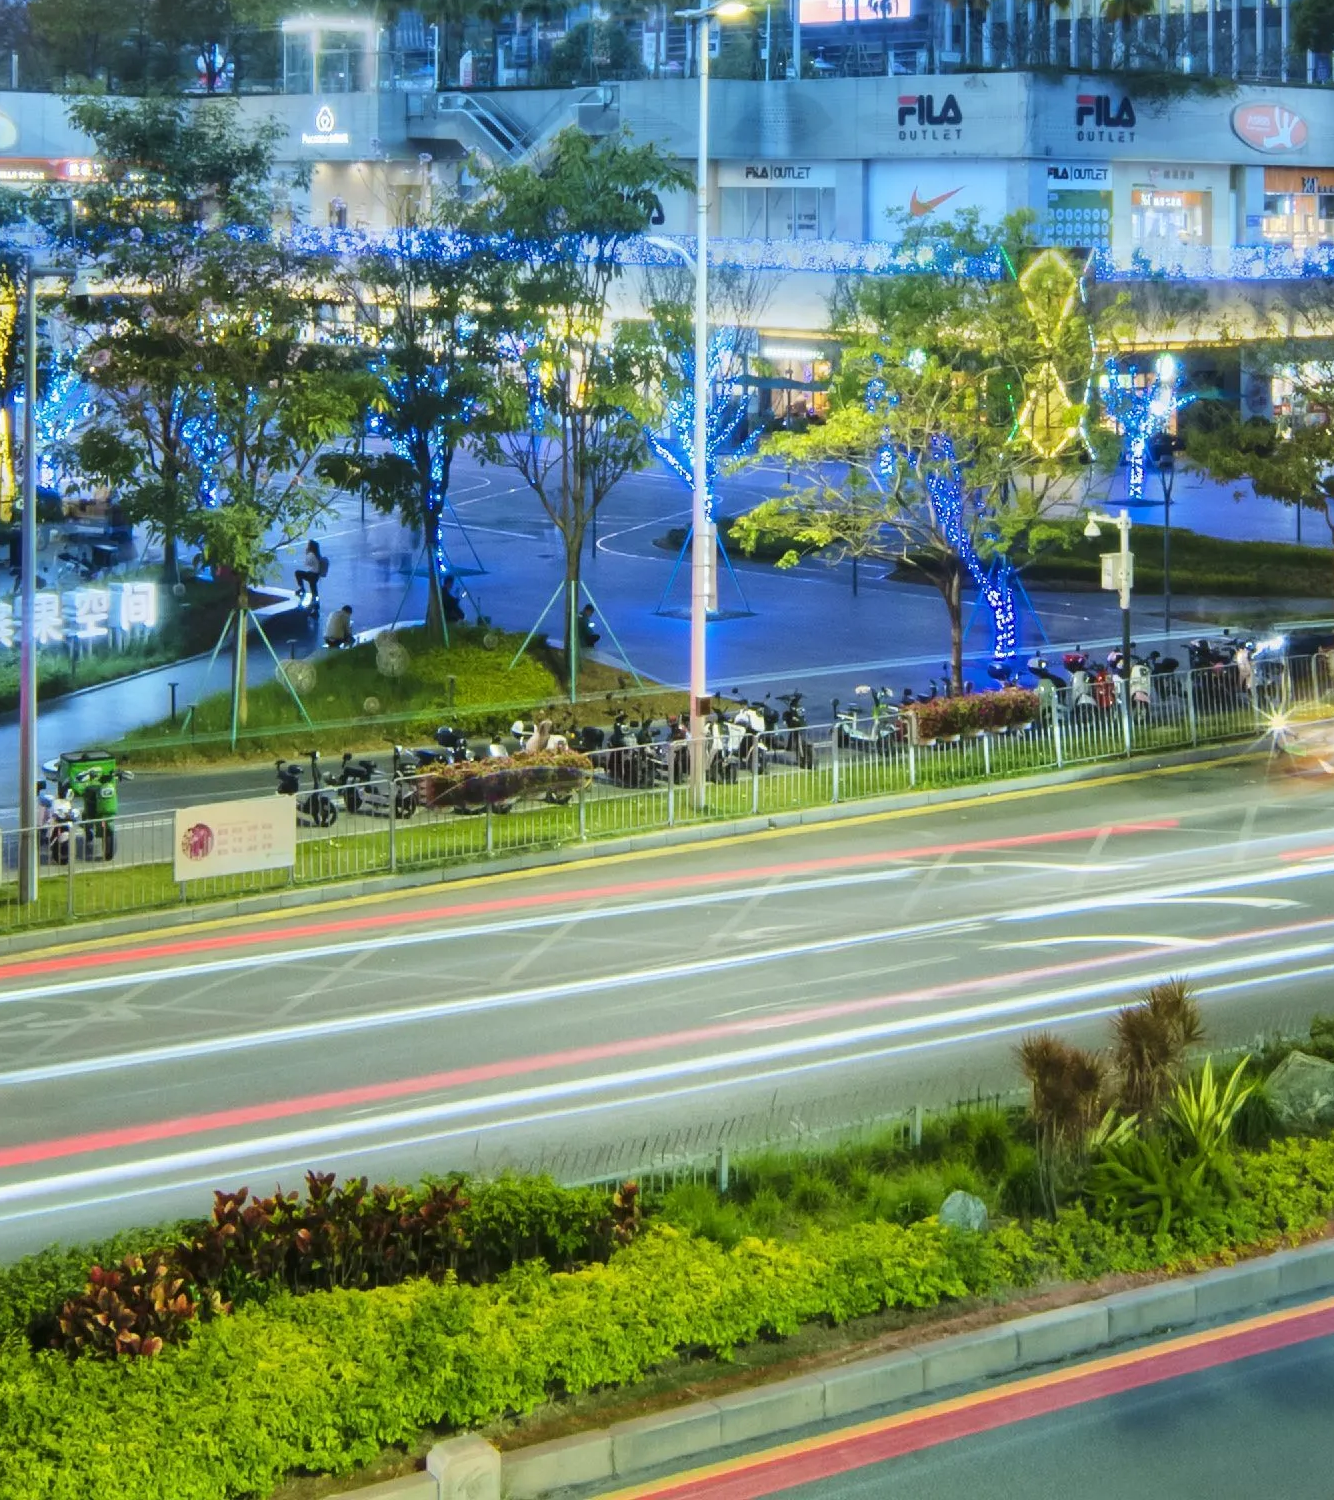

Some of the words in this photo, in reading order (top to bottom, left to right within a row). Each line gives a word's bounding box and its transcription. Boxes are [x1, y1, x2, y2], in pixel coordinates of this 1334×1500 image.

[898, 93, 963, 127] FILA
[1076, 94, 1137, 128] FILA
[898, 128, 963, 141] OUTLET
[1077, 131, 1136, 143] OUTLET
[745, 167, 769, 179] FILA
[773, 167, 812, 179] OUTLET
[1047, 168, 1069, 180] FILA
[1073, 169, 1109, 180] OUTLET
